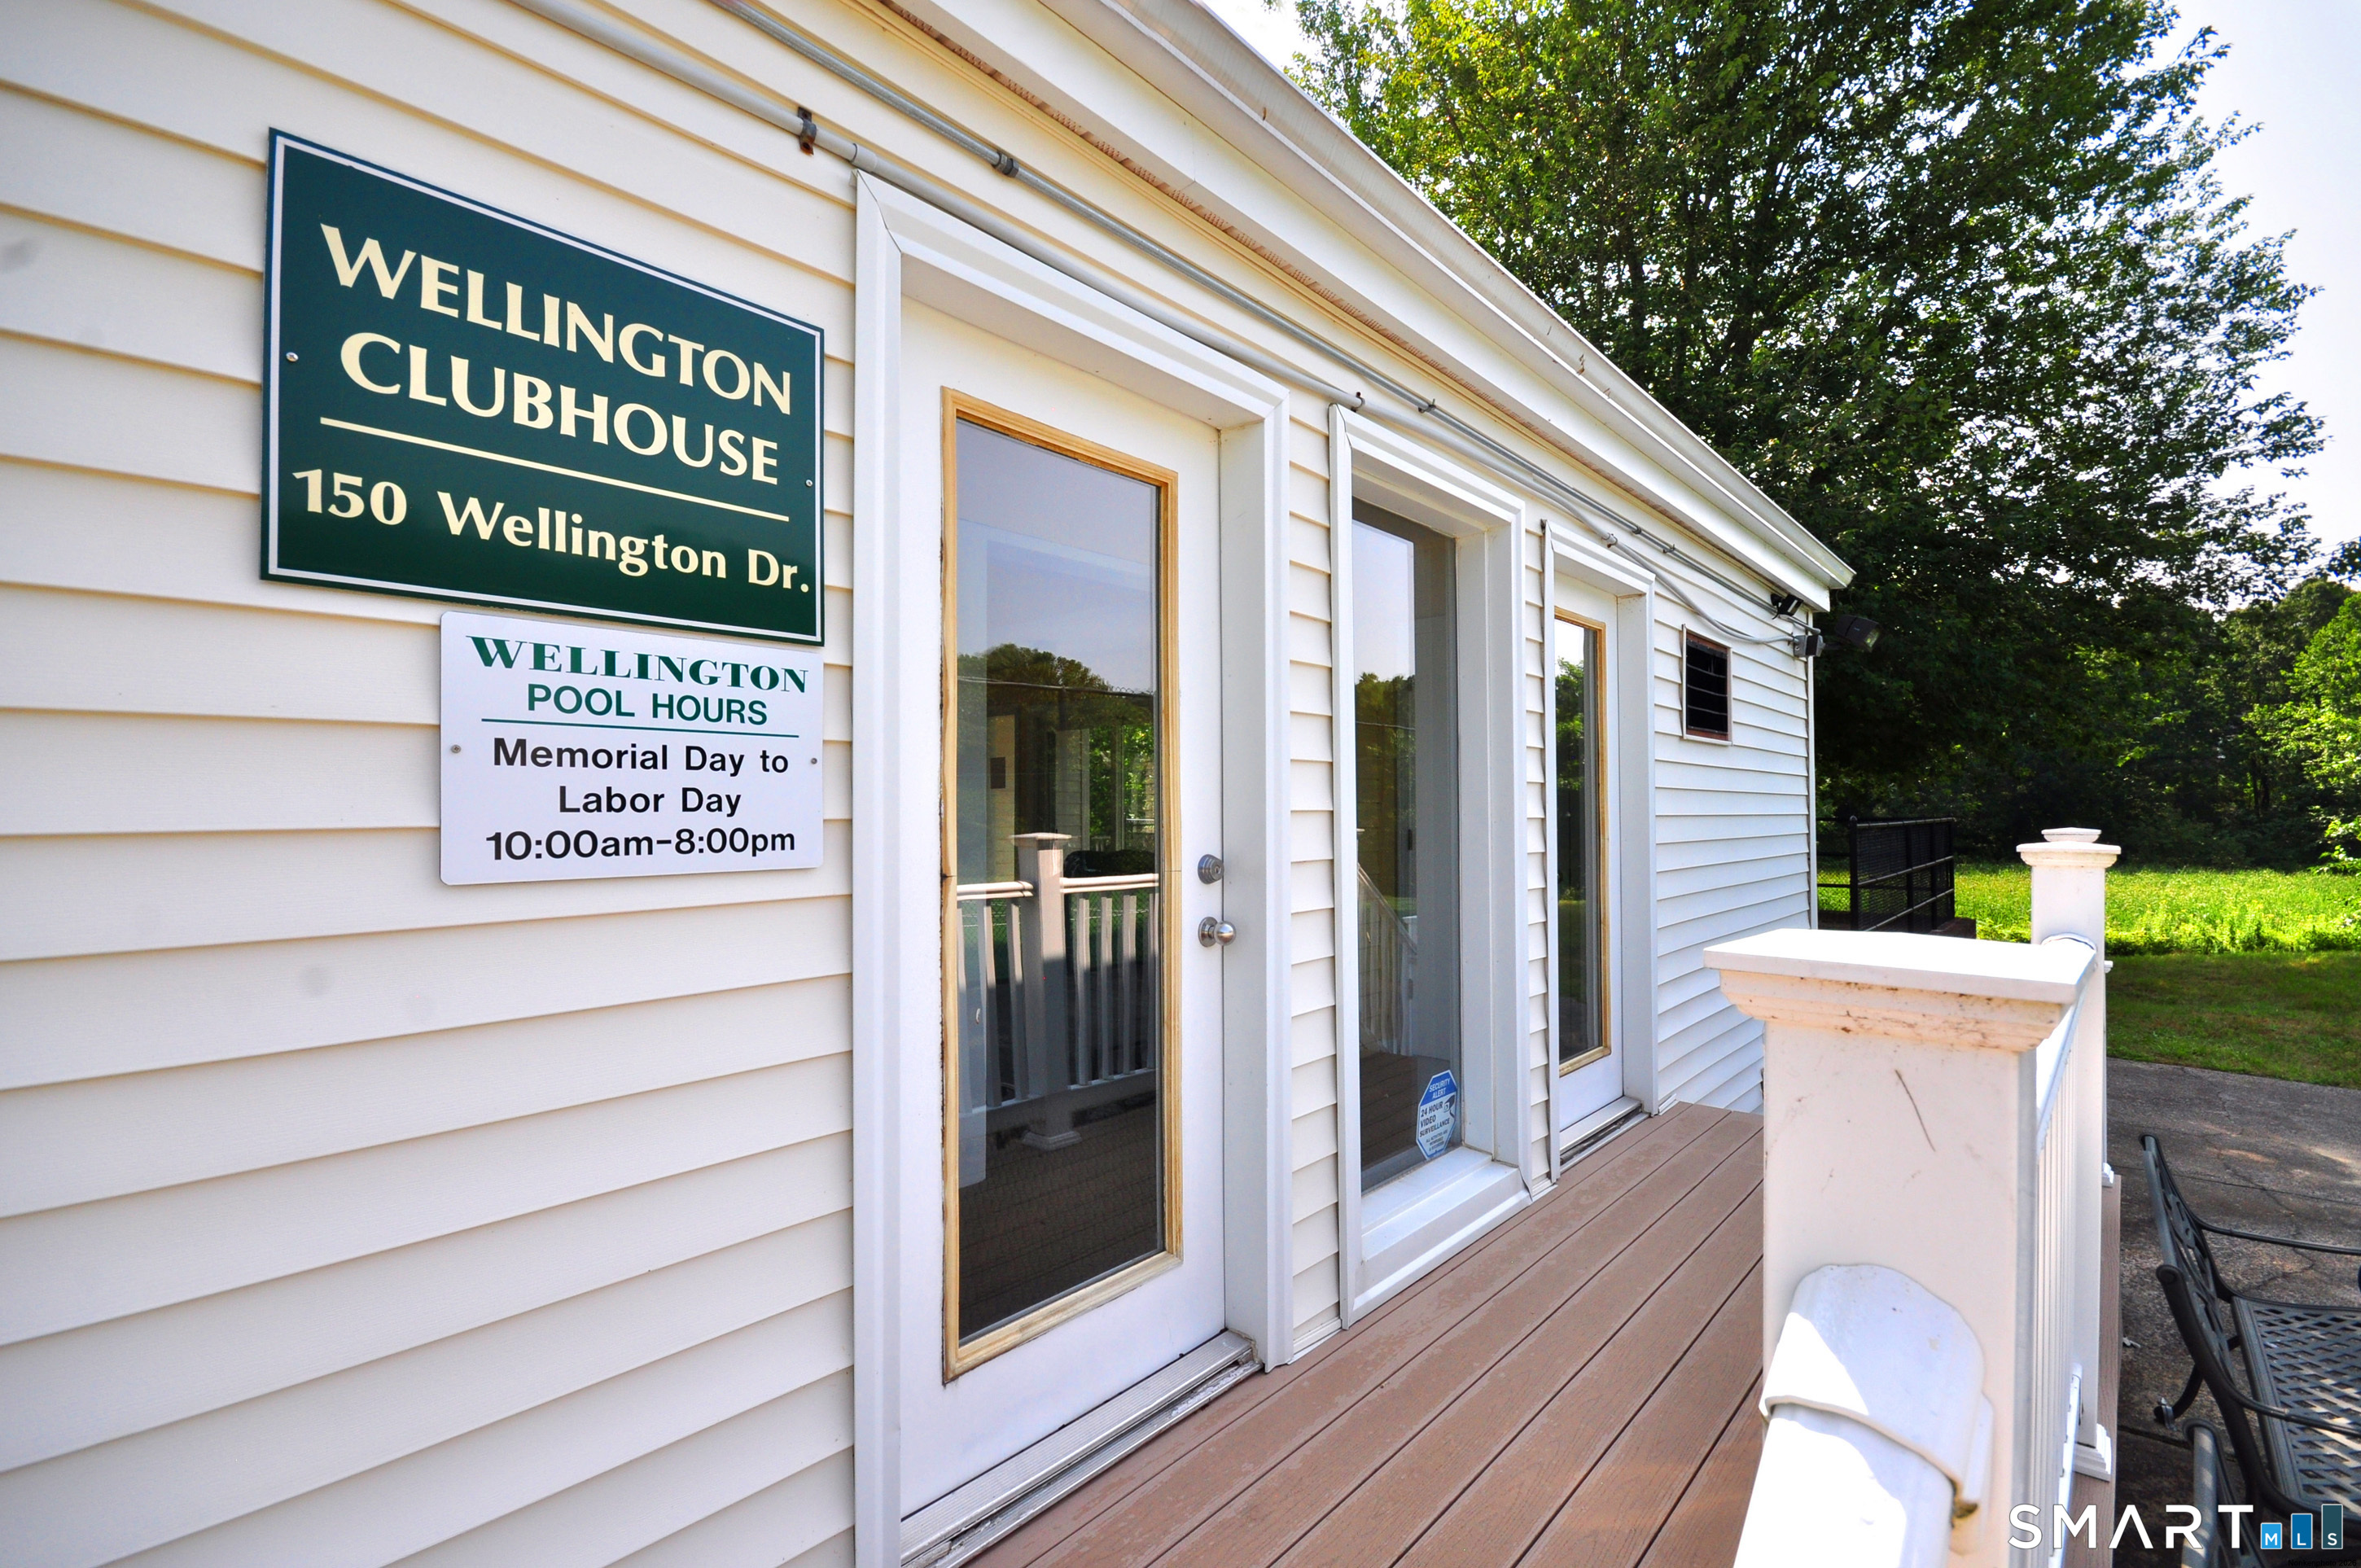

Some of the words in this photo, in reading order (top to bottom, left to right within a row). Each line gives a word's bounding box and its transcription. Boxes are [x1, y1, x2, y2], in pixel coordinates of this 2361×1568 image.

[321, 223, 791, 415] WELLINGTON
[340, 332, 778, 485] CLUBHOUSE
[292, 468, 407, 526] 150
[436, 491, 726, 577] Wellington
[747, 548, 809, 593] Dr.
[466, 635, 808, 694] WELLINGTON
[528, 683, 636, 717] POOL
[652, 693, 768, 726] HOURS
[493, 737, 668, 771] Memorial
[686, 745, 745, 777] Day
[760, 750, 789, 773] to
[559, 785, 665, 813] Labor
[681, 786, 742, 818] Day
[485, 827, 795, 861] 10:00am-8:00pm
[1430, 1079, 1450, 1092] SECURITY
[1433, 1088, 1446, 1099] ALERT
[1421, 1107, 1427, 1117] 24
[1429, 1102, 1443, 1114] HOUR
[1421, 1115, 1436, 1128] VIDEO
[1420, 1119, 1450, 1137] SURVEILLANCE
